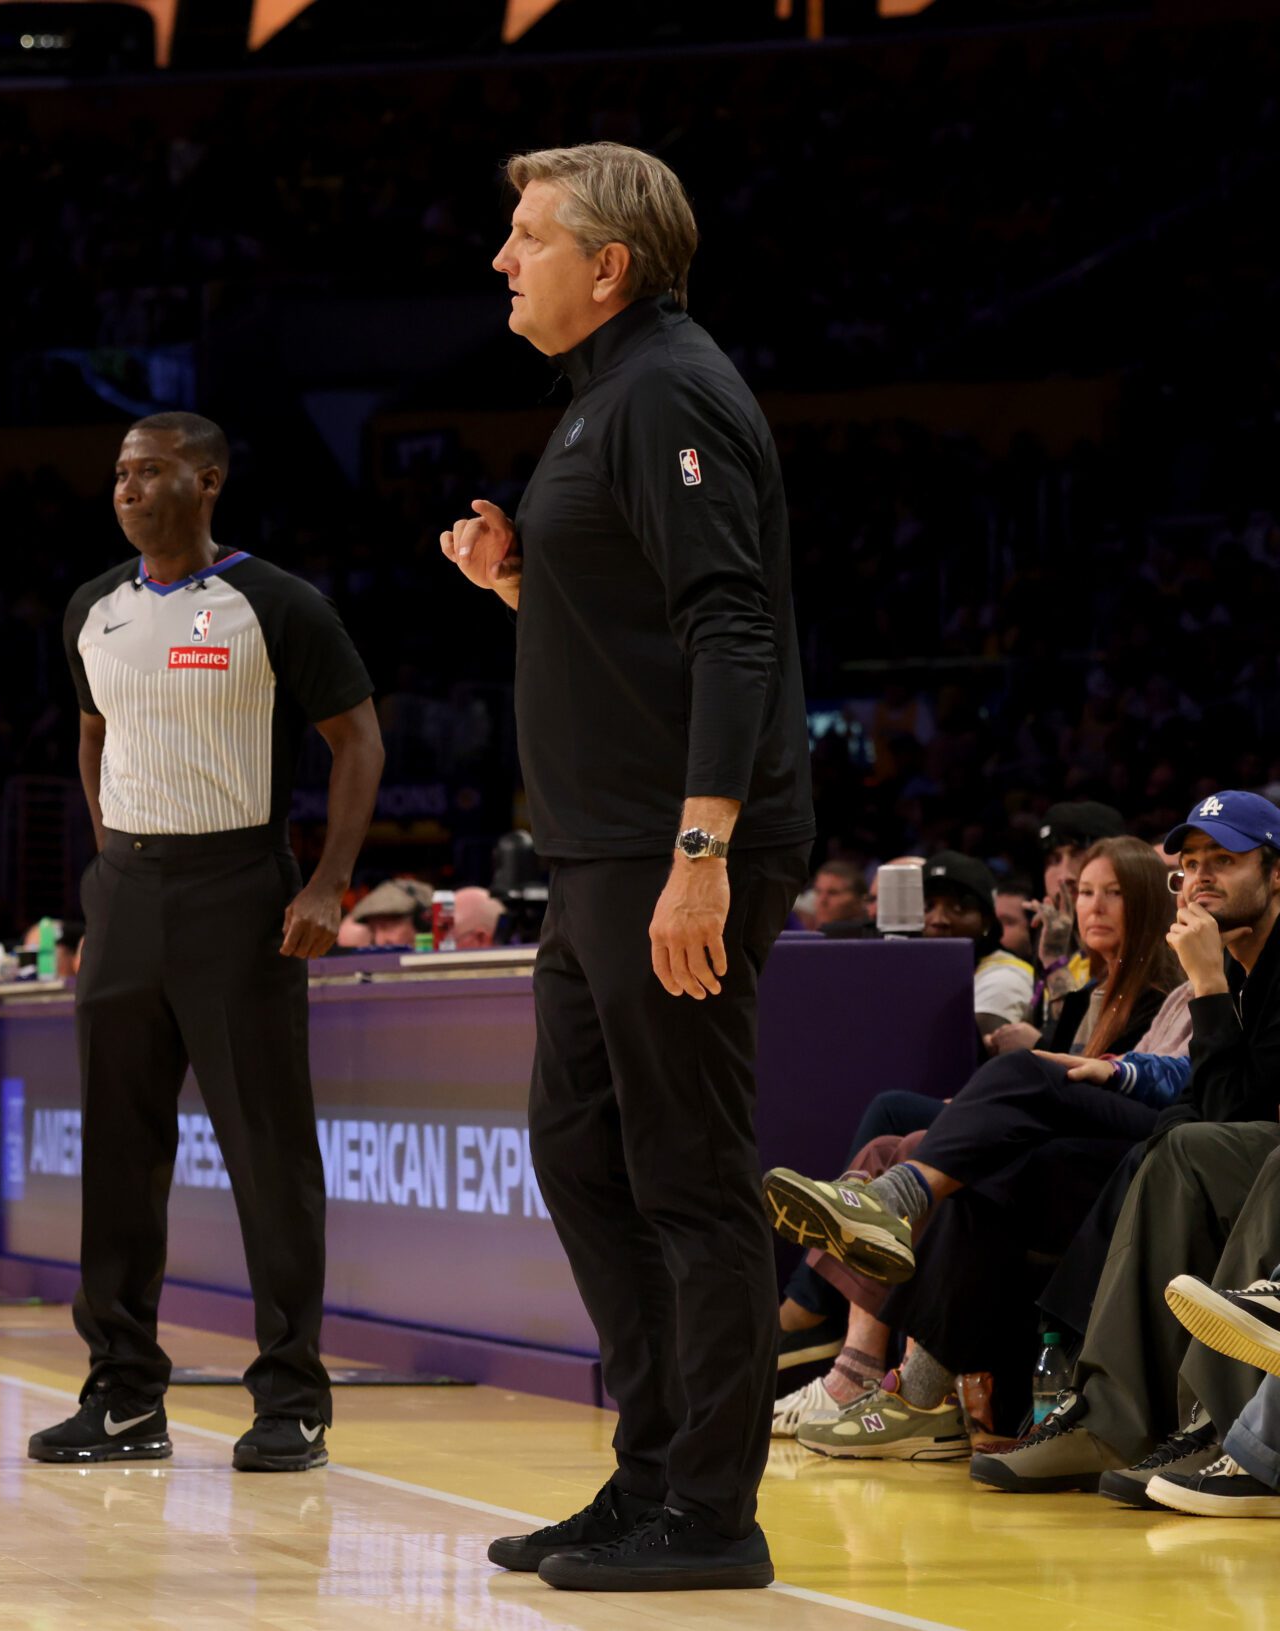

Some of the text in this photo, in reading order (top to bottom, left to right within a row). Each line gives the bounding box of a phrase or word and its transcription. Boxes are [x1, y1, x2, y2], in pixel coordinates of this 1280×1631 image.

[170, 650, 228, 666] Emirates
[1199, 795, 1224, 817] LA
[840, 1188, 861, 1208] N
[863, 1414, 884, 1432] N
